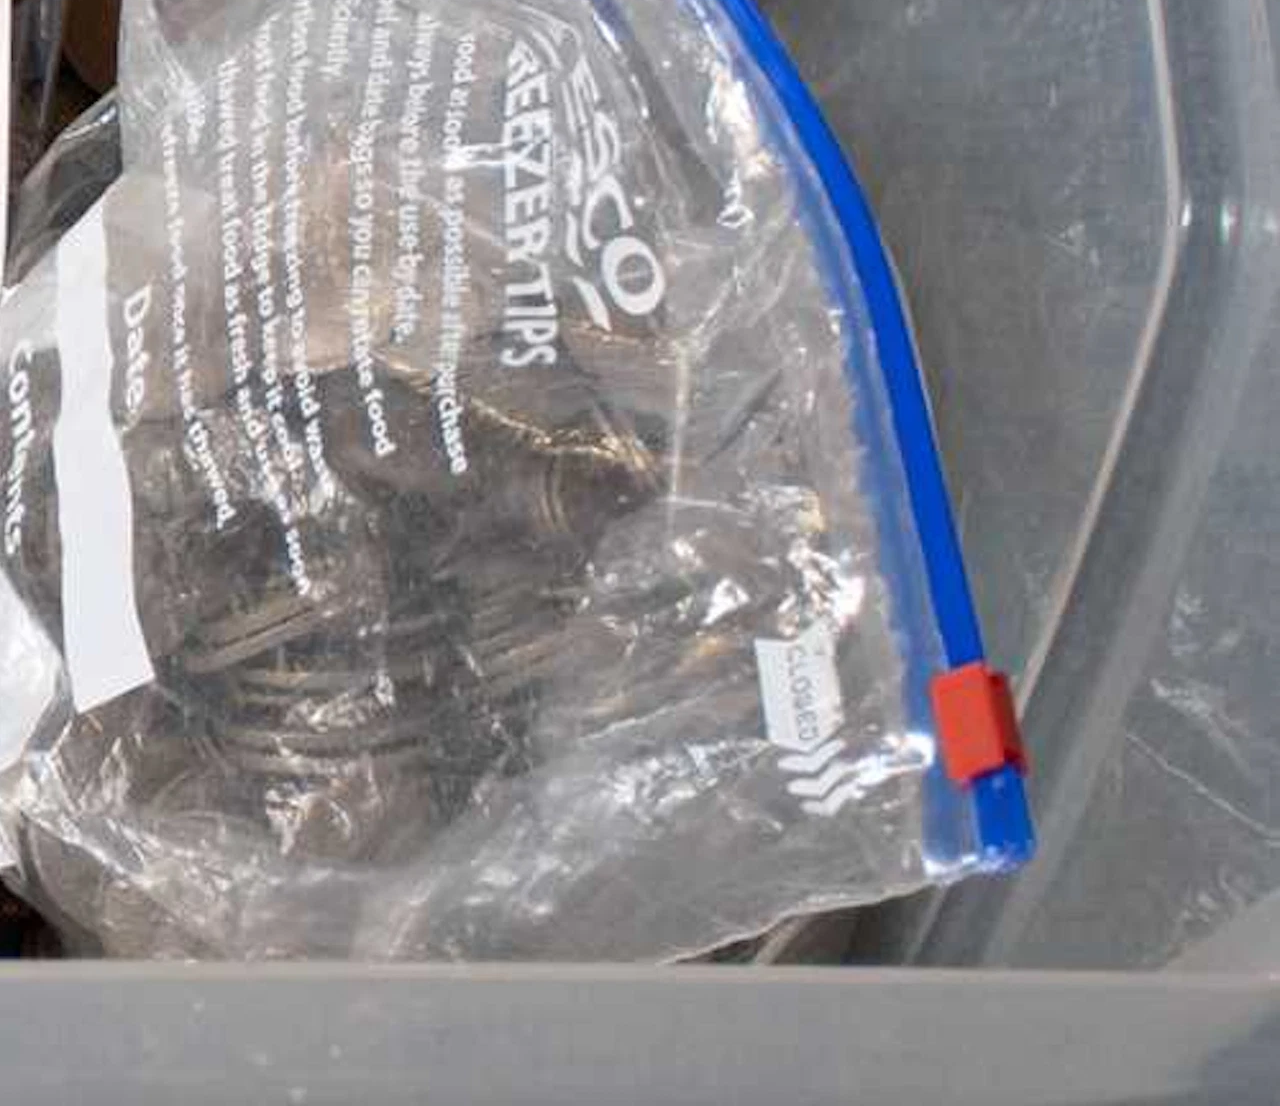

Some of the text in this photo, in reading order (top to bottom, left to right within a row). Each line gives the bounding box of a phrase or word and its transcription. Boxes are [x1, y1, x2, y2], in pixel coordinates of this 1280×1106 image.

[370, 26, 393, 71] and
[216, 58, 236, 150] thawed
[351, 213, 374, 262] you
[502, 40, 560, 368] REEZER TIPS
[222, 216, 240, 280] food
[437, 205, 468, 307] possible
[259, 284, 274, 319] to
[124, 283, 152, 413] Date
[227, 313, 252, 384] fresh
[4, 337, 36, 556] Contents
[237, 387, 267, 438] and
[362, 388, 396, 457] food
[435, 361, 469, 474] purchase
[283, 527, 312, 595] soon
